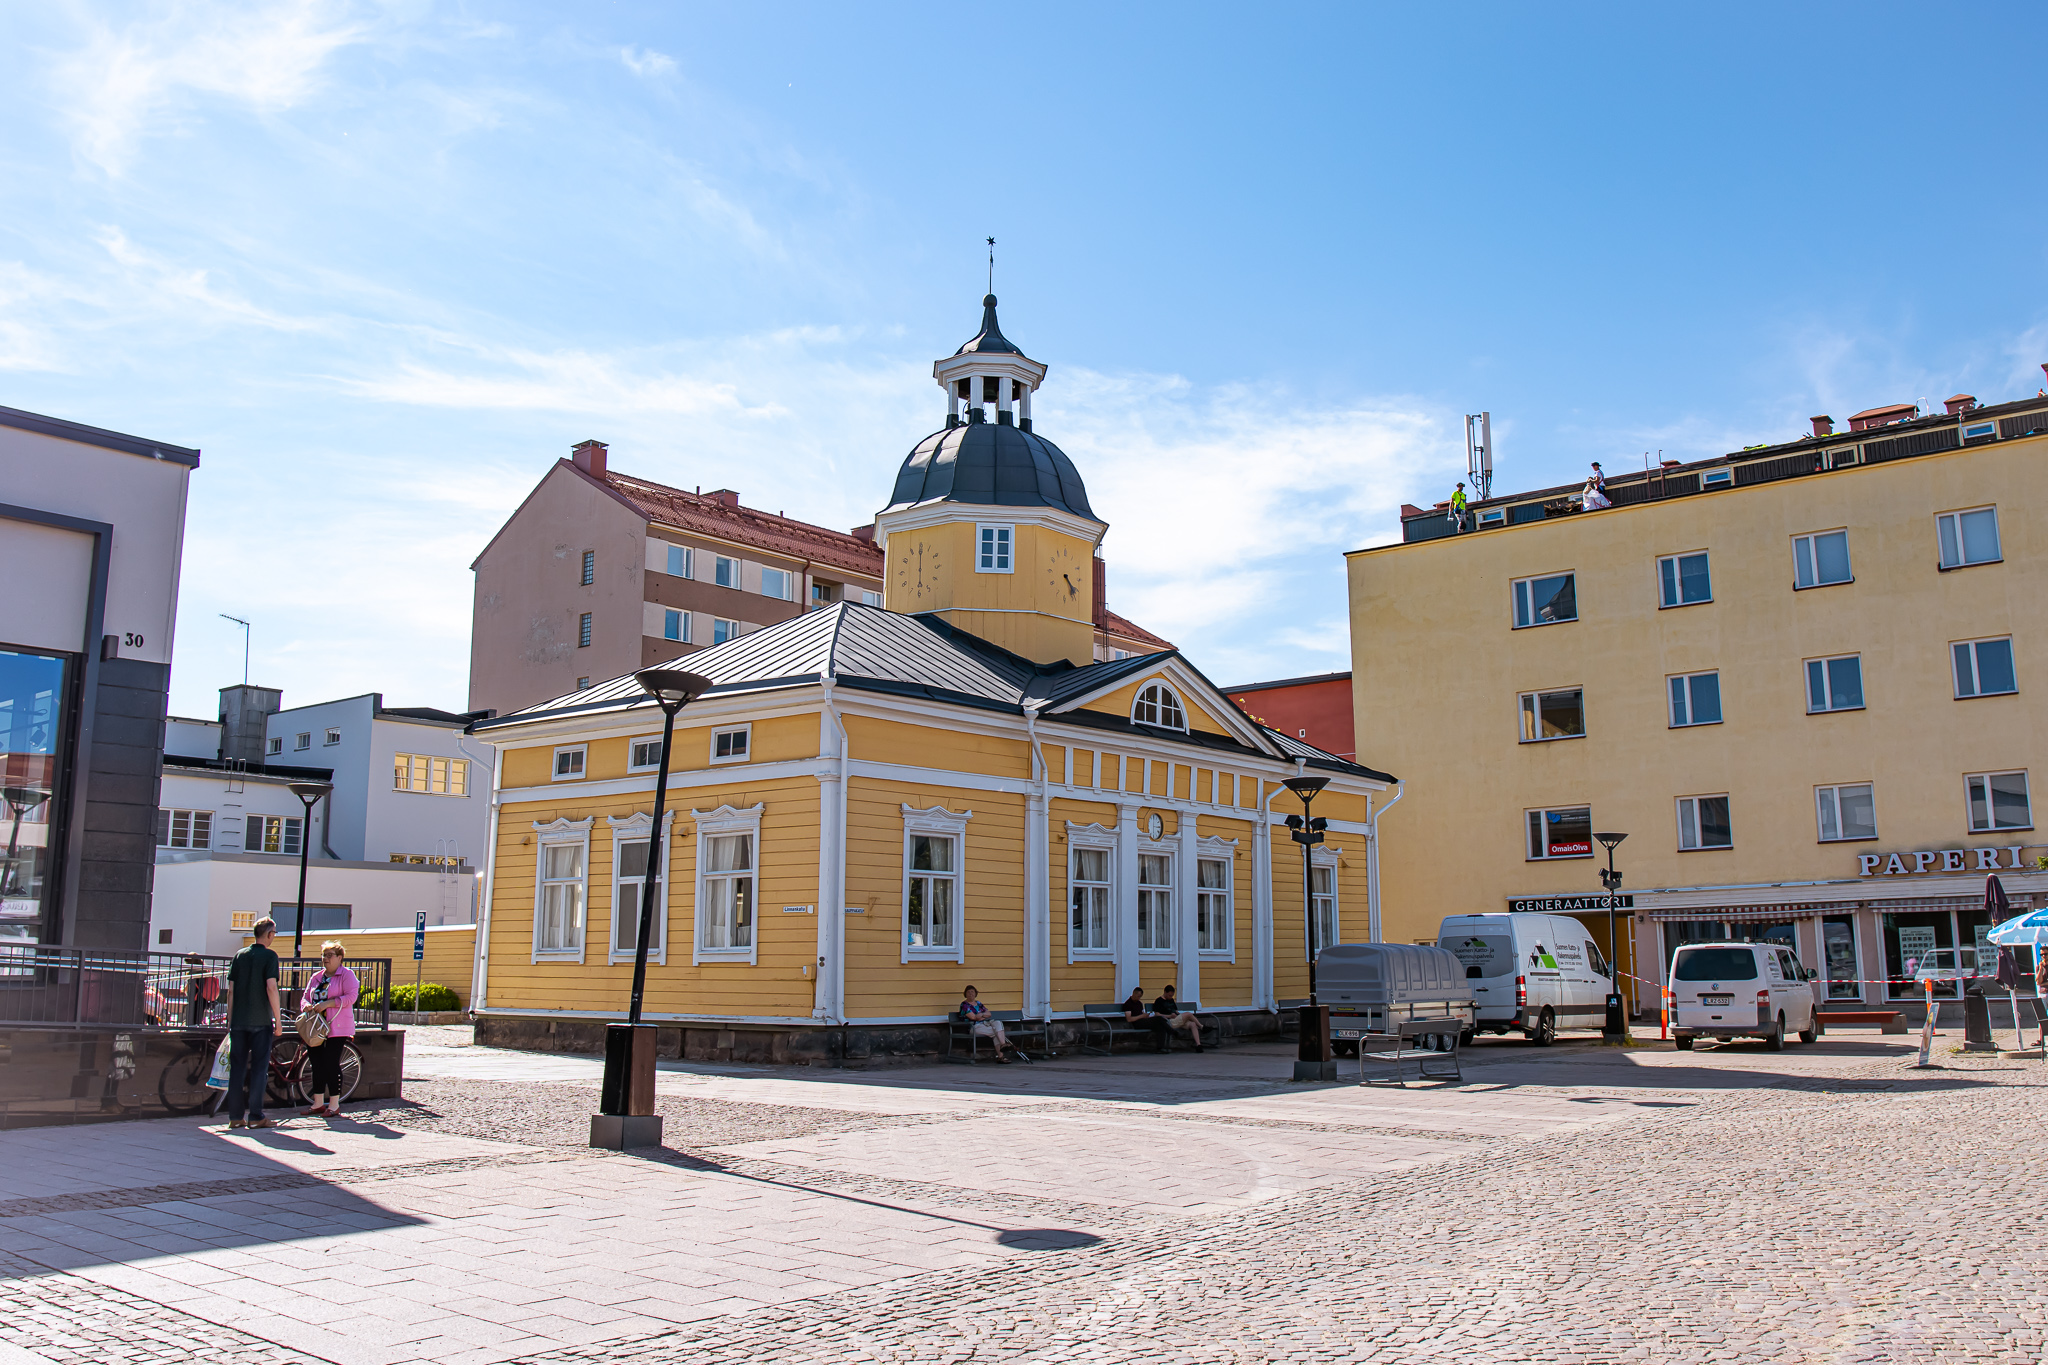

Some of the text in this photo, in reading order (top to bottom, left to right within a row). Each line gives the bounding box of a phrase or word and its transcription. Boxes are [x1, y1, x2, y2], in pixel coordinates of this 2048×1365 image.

[125, 632, 144, 648] 30
[1551, 844, 1588, 853] OmaisOiva
[1857, 846, 2024, 876] PAPERI
[1515, 896, 1626, 911] GENERAATTORI
[417, 913, 425, 929] P
